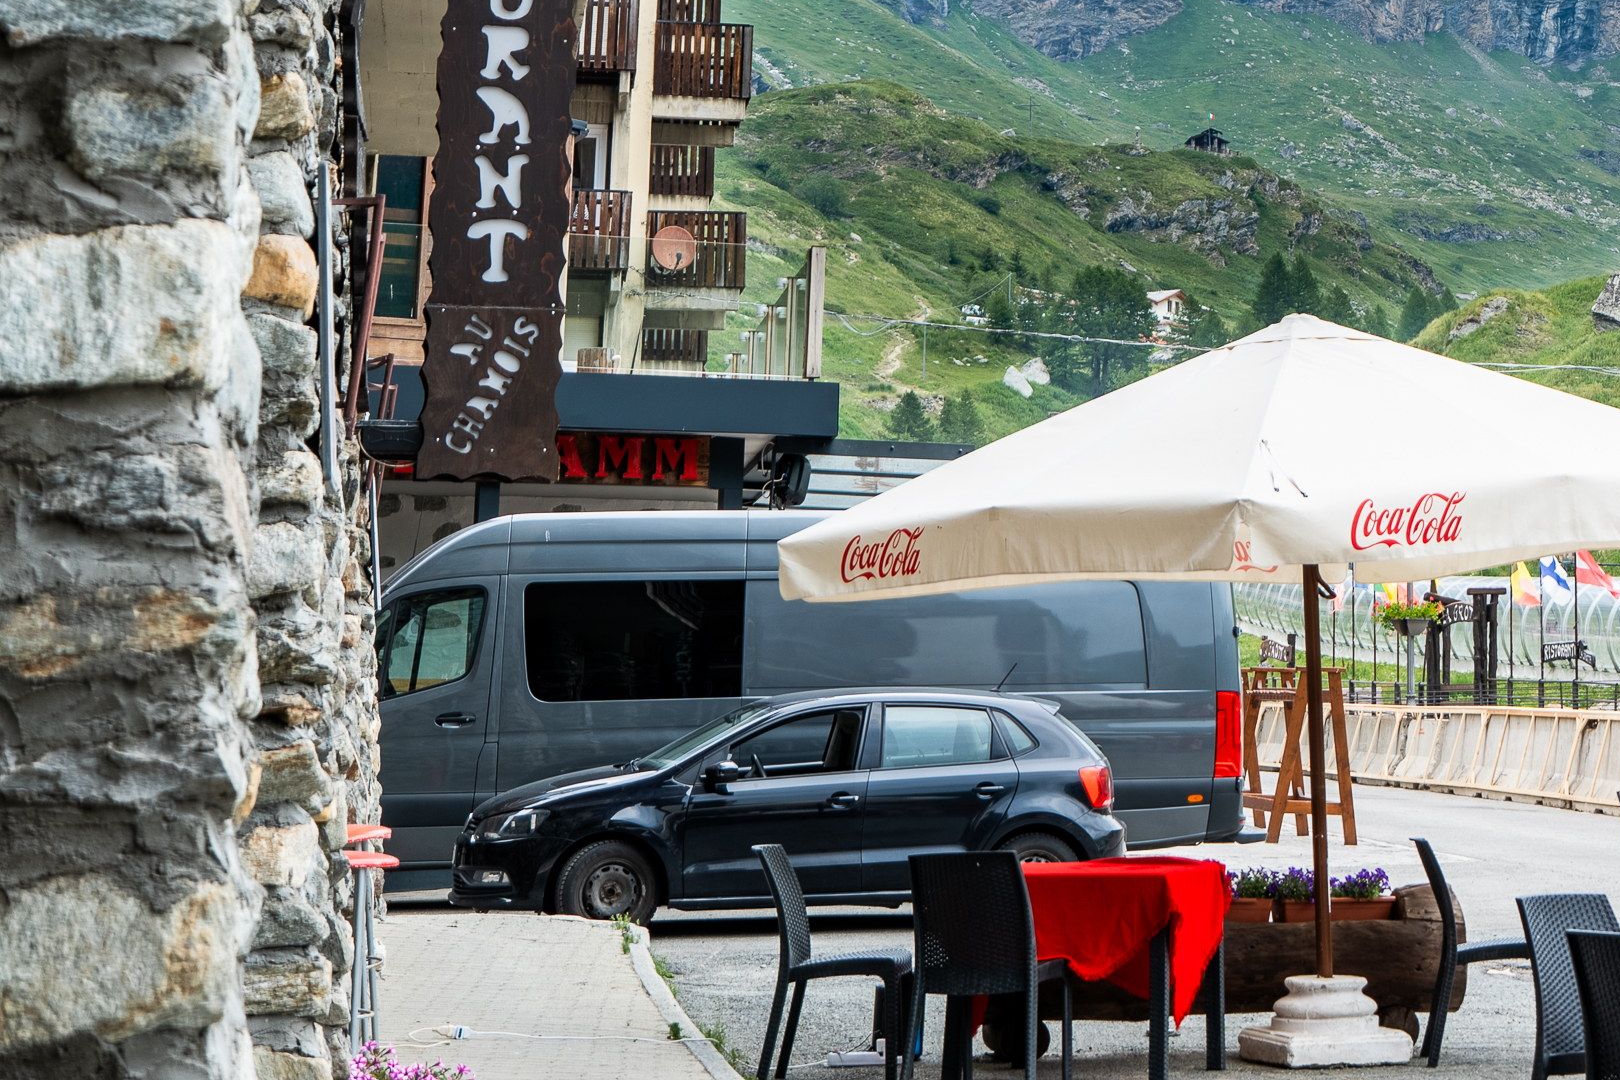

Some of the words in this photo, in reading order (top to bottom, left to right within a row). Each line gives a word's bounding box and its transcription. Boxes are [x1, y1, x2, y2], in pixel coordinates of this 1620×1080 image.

[450, 314, 493, 366] AU
[445, 315, 540, 455] CHAMOIS
[557, 435, 699, 481] AMM
[1350, 491, 1467, 551] Coca-Cola
[840, 526, 926, 584] Coca-Cola
